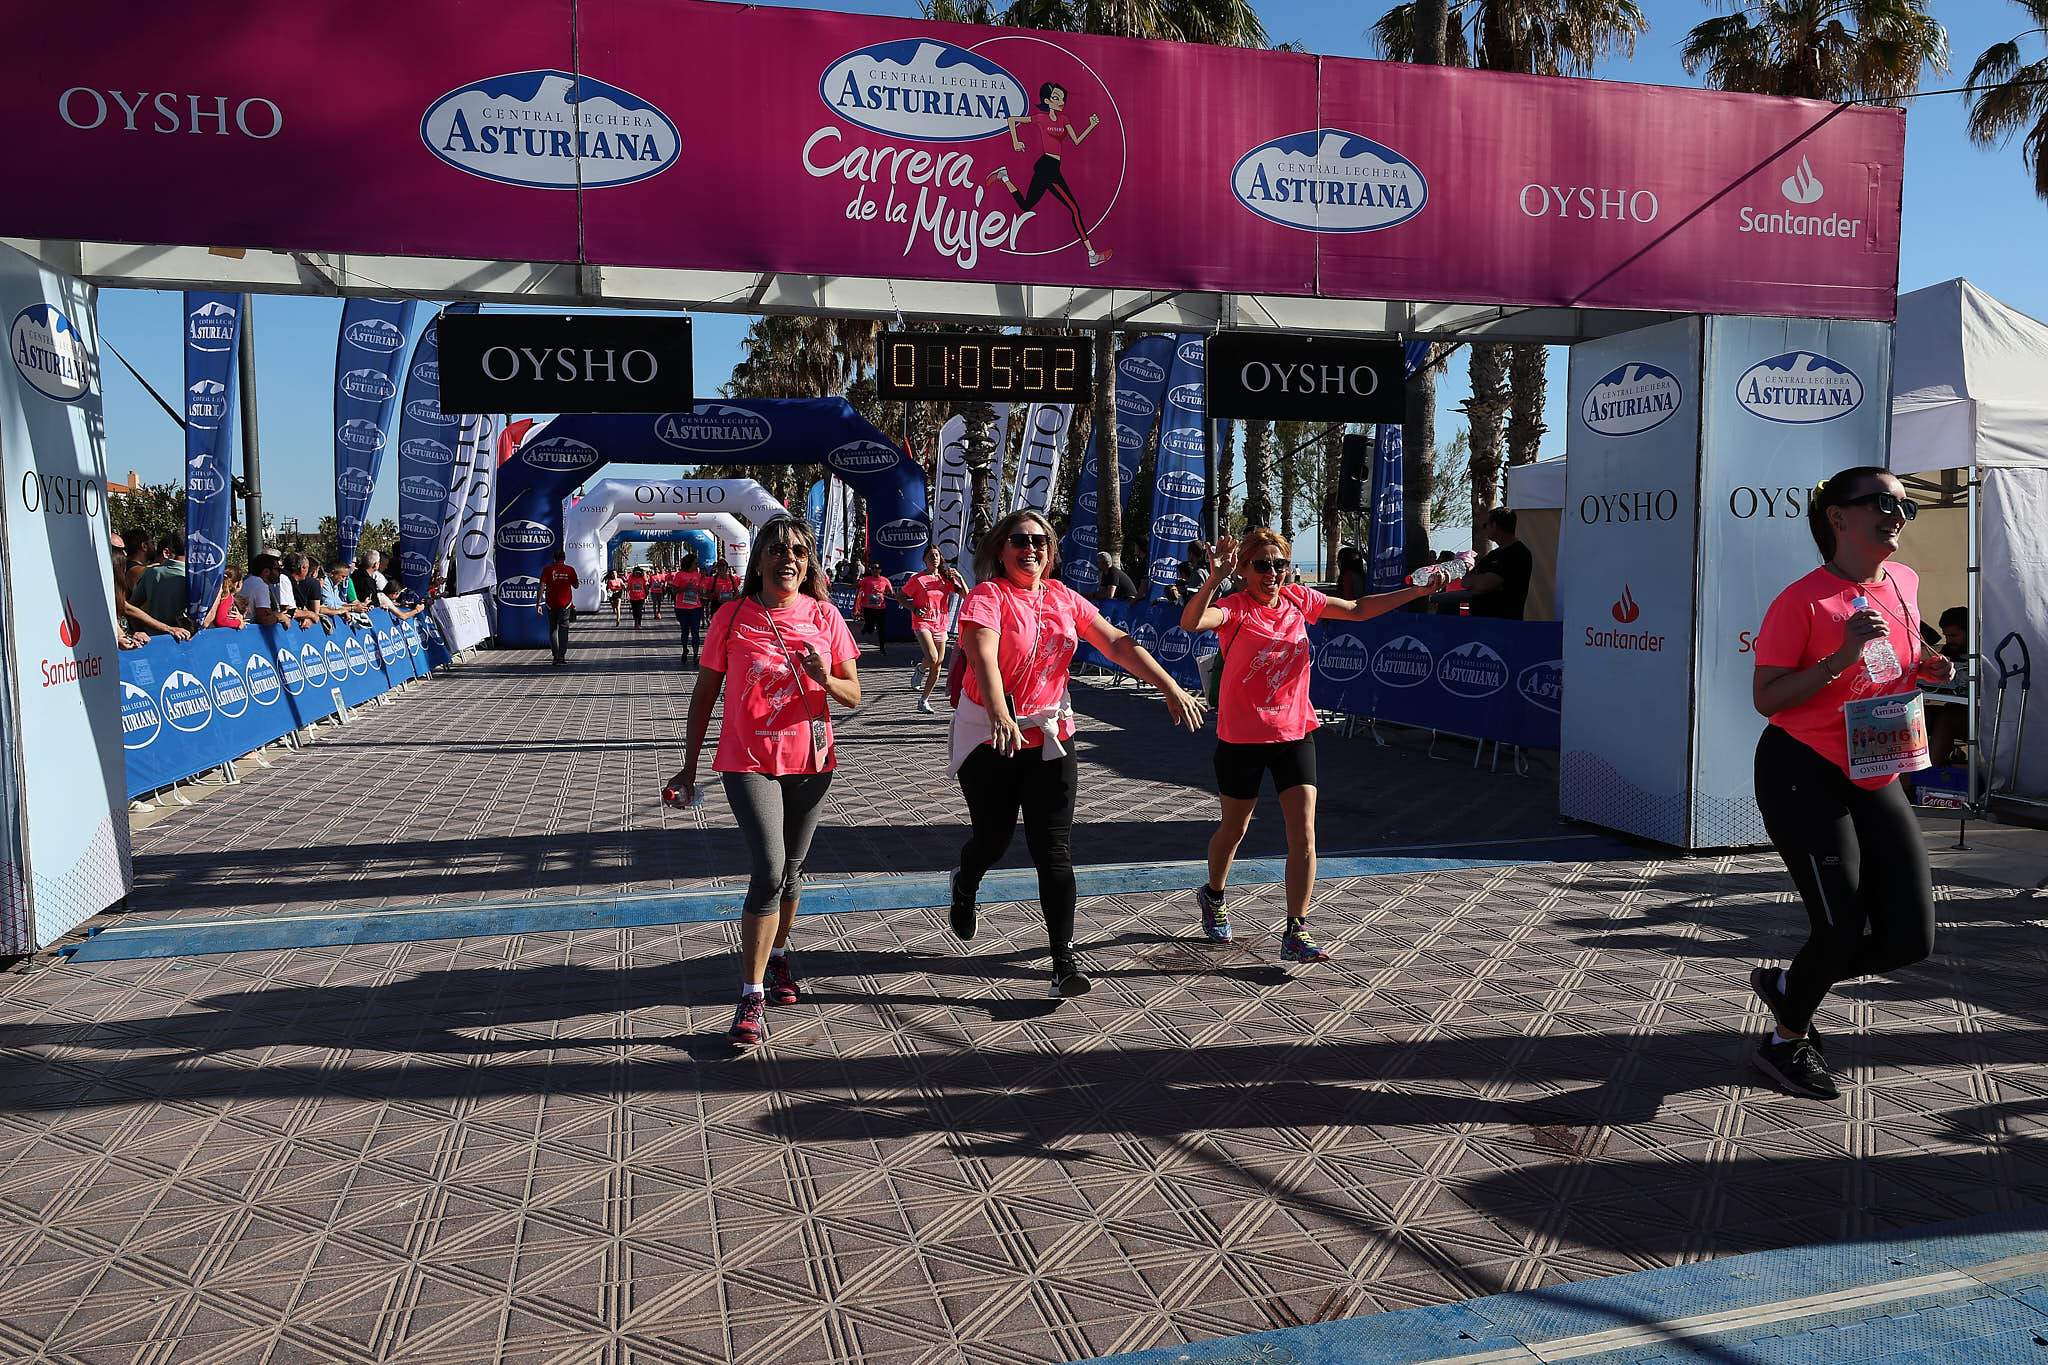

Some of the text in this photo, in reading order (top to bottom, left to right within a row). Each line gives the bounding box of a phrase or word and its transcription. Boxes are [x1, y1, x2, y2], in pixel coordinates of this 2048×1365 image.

[869, 68, 1007, 91] CENTRAL LECHERA
[836, 68, 1011, 120] ASTURIANA
[58, 85, 283, 139] OYSHO
[482, 107, 563, 123] CENTRAL
[442, 108, 662, 162] ASTURIANA
[801, 125, 975, 189] Carrera
[1277, 162, 1408, 179] CENTRAL LECHERA
[1246, 162, 1413, 209] ASTURIANA
[1519, 183, 1659, 223] OYSHO
[845, 184, 1037, 270] de la Mujer
[1738, 206, 1861, 238] Santander
[17, 327, 88, 385] ASTURIANA
[481, 346, 658, 384] OYSHO
[893, 343, 1076, 391] 01:05:52
[1240, 361, 1379, 396] OYSHO
[1601, 381, 1671, 400] CENTRAL LECHERA
[1744, 377, 1853, 406] ASTURIANA
[1765, 375, 1851, 386] CENTRAL LECHERA
[1172, 393, 1204, 406] ASTUR
[1587, 391, 1674, 423] ASTURIANA
[664, 416, 764, 441] ASTURIANA
[404, 442, 450, 462] ASTURIANA
[527, 449, 593, 463] ASTURIANA
[1165, 435, 1205, 452] ASTURIA
[834, 453, 895, 465] ASTURIANA
[1018, 404, 1065, 513] YSHO
[22, 470, 99, 518] OYSHO
[634, 485, 726, 504] OYSHO
[1580, 489, 1678, 525] OYSHO
[1729, 486, 1811, 519] OYS
[500, 531, 551, 544] ASTURIANA
[1584, 626, 1665, 652] Santander
[41, 652, 103, 688] Santander
[1319, 650, 1364, 671] ASTURIANA
[1375, 653, 1428, 677] ASTURIANA
[1439, 659, 1500, 687] ASTURIANA
[121, 708, 160, 733] TURIANA
[165, 694, 211, 721] ASTURIANA
